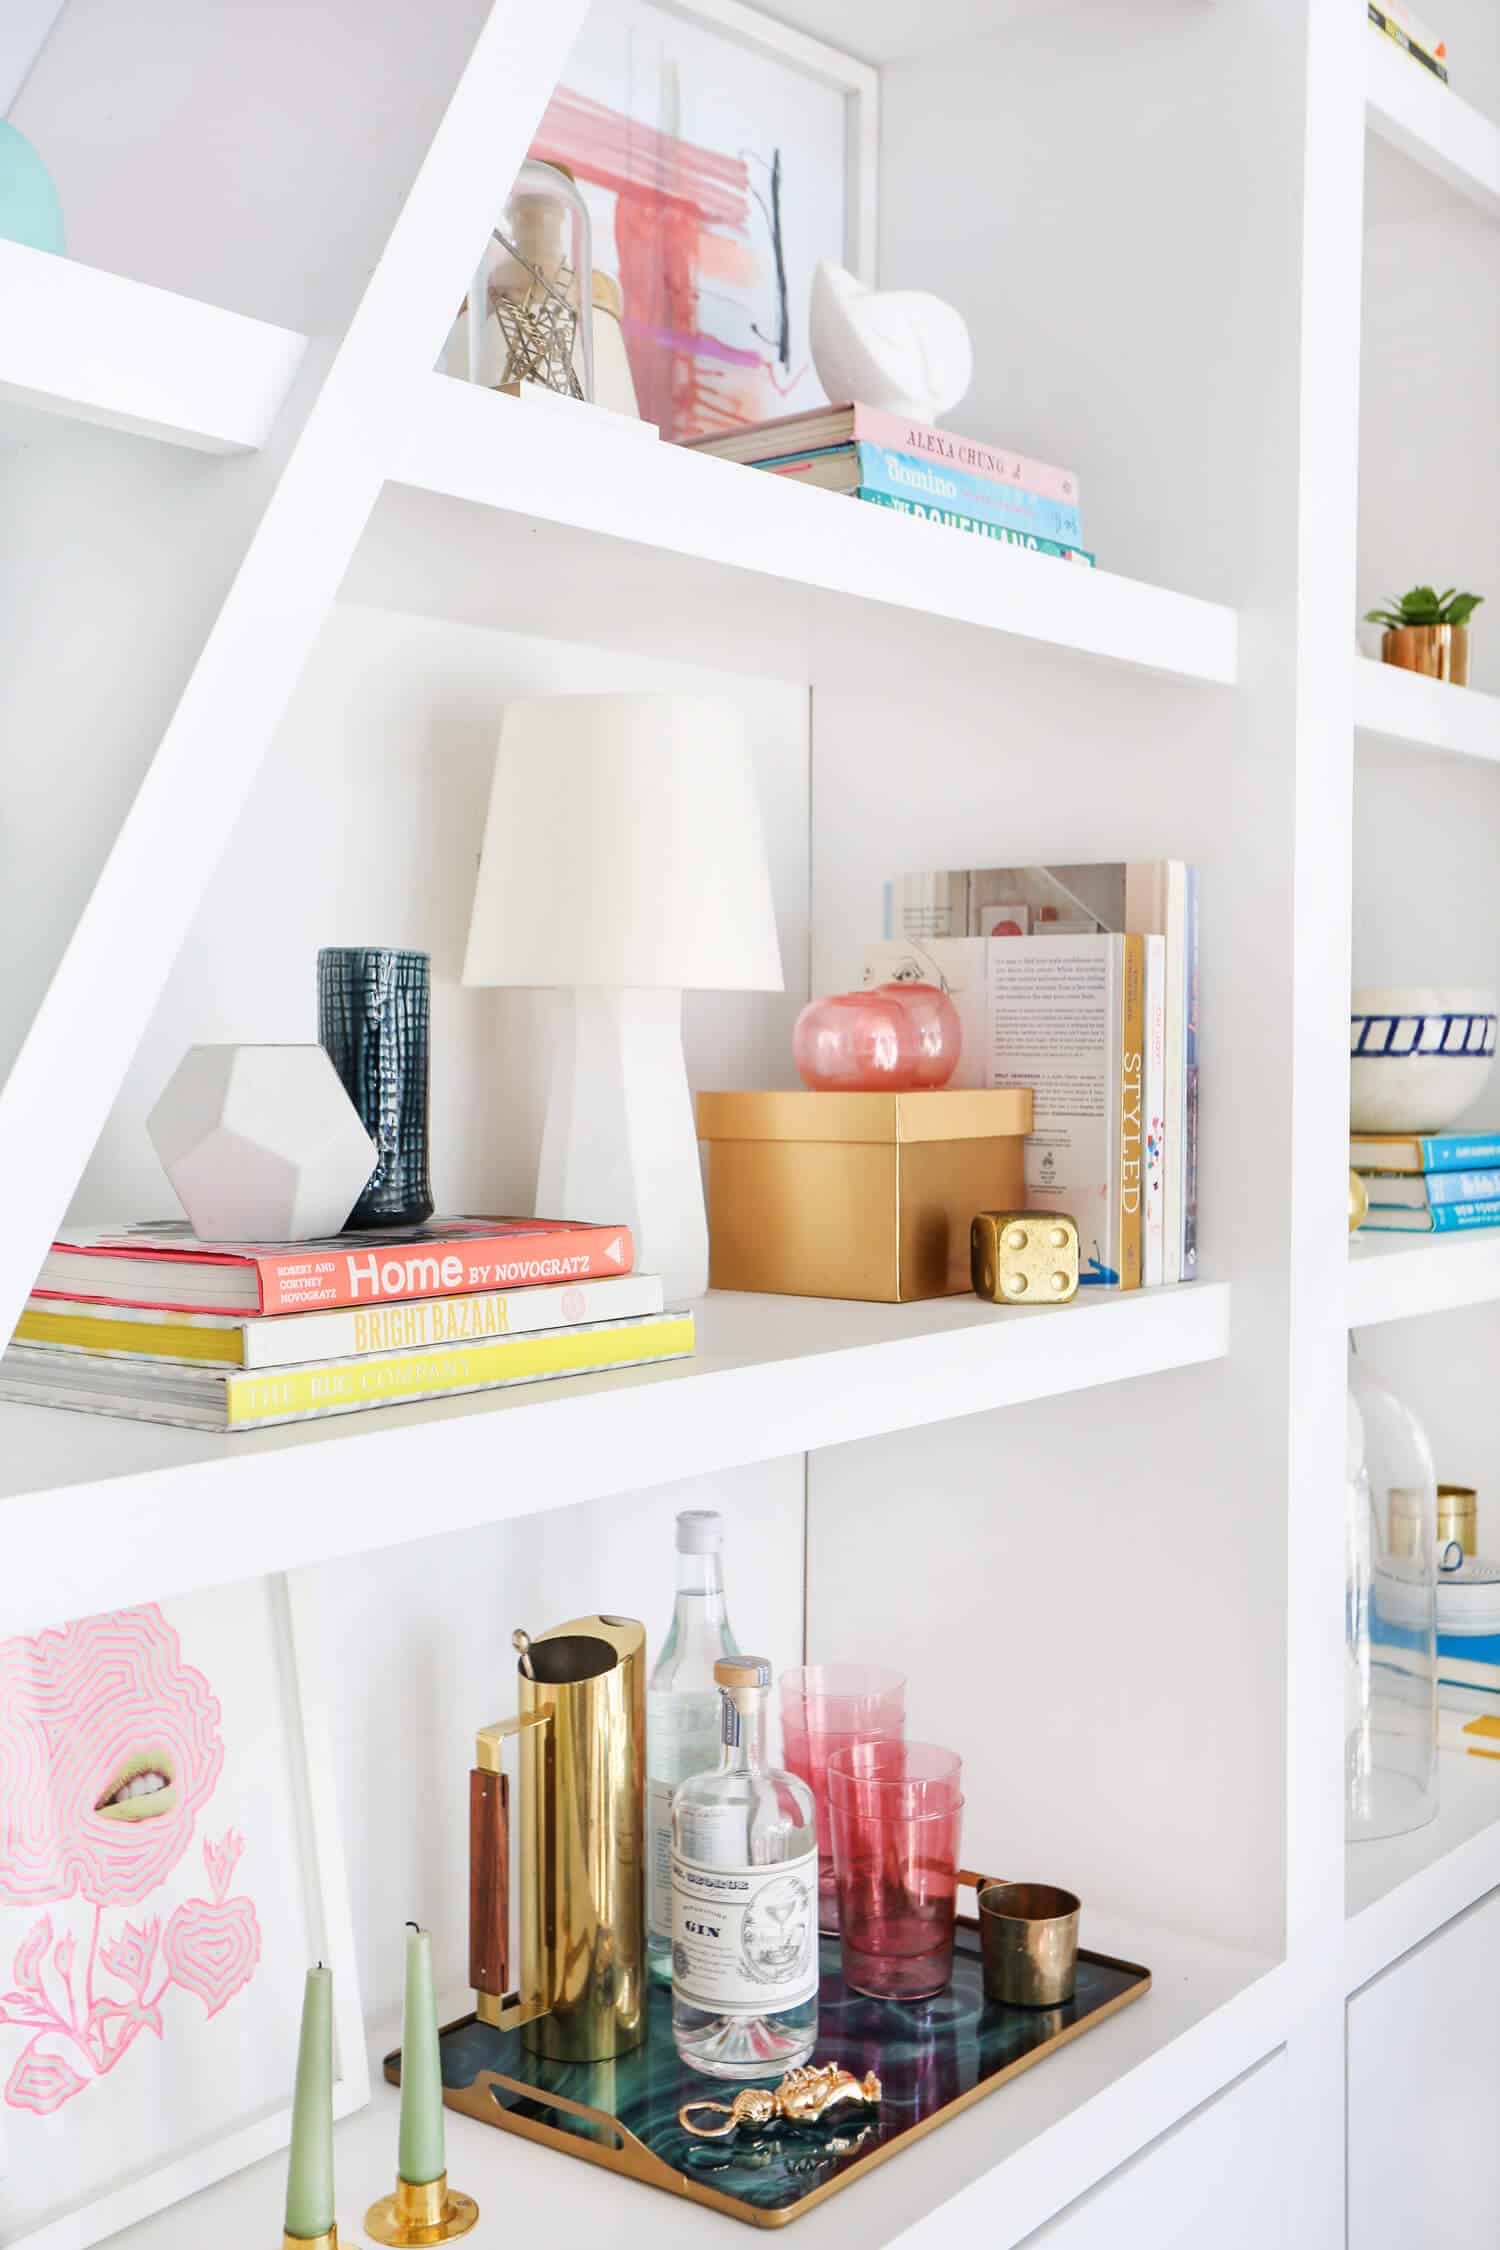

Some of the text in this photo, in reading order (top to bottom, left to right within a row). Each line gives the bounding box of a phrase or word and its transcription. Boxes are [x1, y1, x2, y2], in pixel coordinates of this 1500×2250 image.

[906, 431, 954, 460] ALEXA
[957, 447, 1005, 473] CHUNG
[1123, 1052, 1142, 1214] STYLED
[277, 1262, 335, 1276] ROBERT AND
[346, 1253, 590, 1298] Home BY NOVOGRATZ
[280, 1288, 337, 1304] NOVOGRATZ
[353, 1296, 509, 1352] BRIGHT BAZAAR
[248, 1358, 472, 1408] THE RUG COMPANY
[685, 1920, 720, 1938] GIN
